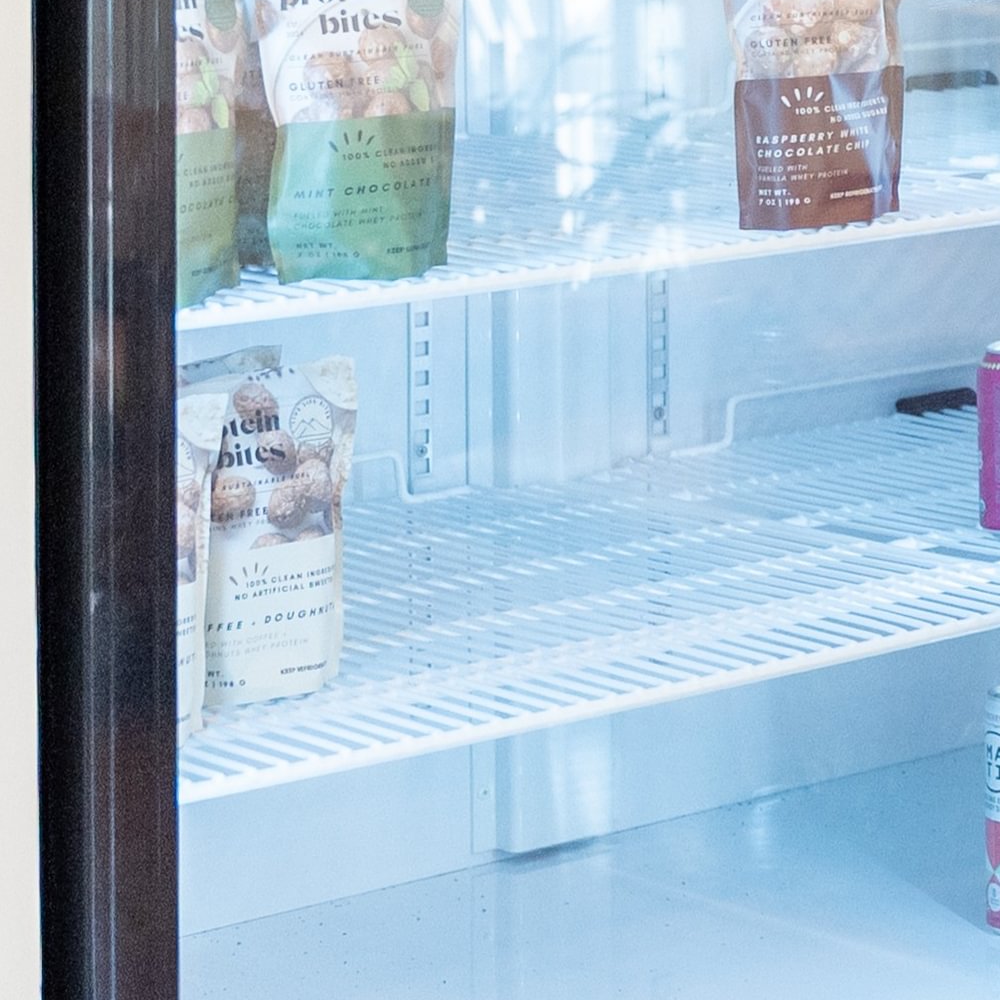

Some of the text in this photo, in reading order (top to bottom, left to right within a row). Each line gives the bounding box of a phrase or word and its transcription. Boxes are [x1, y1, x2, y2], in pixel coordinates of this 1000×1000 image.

[319, 9, 402, 35] bites
[750, 35, 832, 49] GLUTEN FREE
[289, 77, 344, 92] GLUTEN
[795, 106, 821, 116] 100%
[756, 131, 835, 146] RASPBERRY
[757, 138, 870, 159] CHOCOLATE CHIP
[293, 177, 432, 199] MINT CHOCOLATE
[271, 572, 304, 583] CLEAN
[234, 583, 306, 600] NO ARTIFICIAL
[206, 620, 244, 632] FFEE
